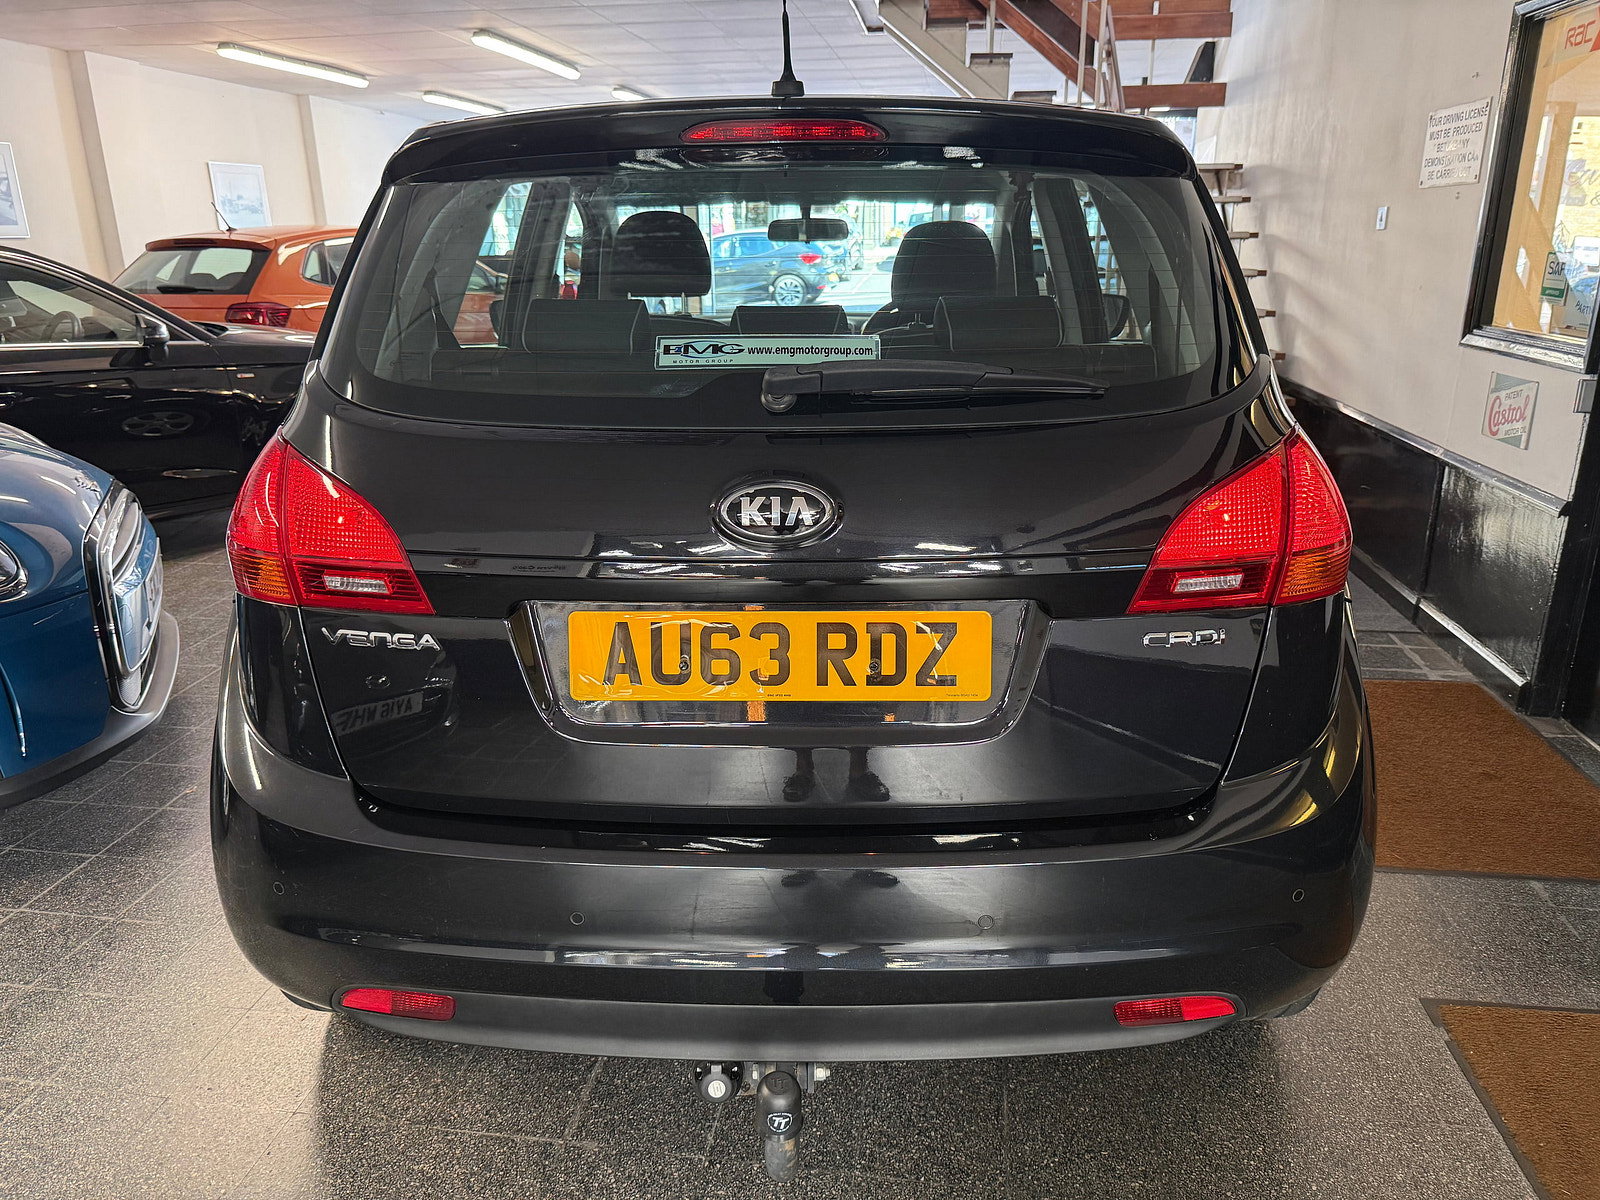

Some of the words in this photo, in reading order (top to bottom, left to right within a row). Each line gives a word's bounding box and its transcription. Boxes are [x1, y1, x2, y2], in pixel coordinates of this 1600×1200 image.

[1443, 112, 1464, 125] DRIVING
[1465, 106, 1488, 120] LICENSE
[1429, 129, 1443, 141] MUST
[1443, 127, 1451, 138] BE
[1452, 121, 1483, 137] PRODUCED
[1427, 170, 1435, 180] BE
[663, 344, 745, 355] EMG
[747, 343, 873, 357] www.emgmotorgroup.com
[1504, 389, 1523, 401] PATENT
[1488, 394, 1530, 436] Castrol
[1504, 427, 1520, 436] MOTOR
[740, 496, 813, 526] KIA
[321, 627, 440, 650] VENGA
[602, 622, 790, 686] AU63
[816, 622, 957, 686] RDZ
